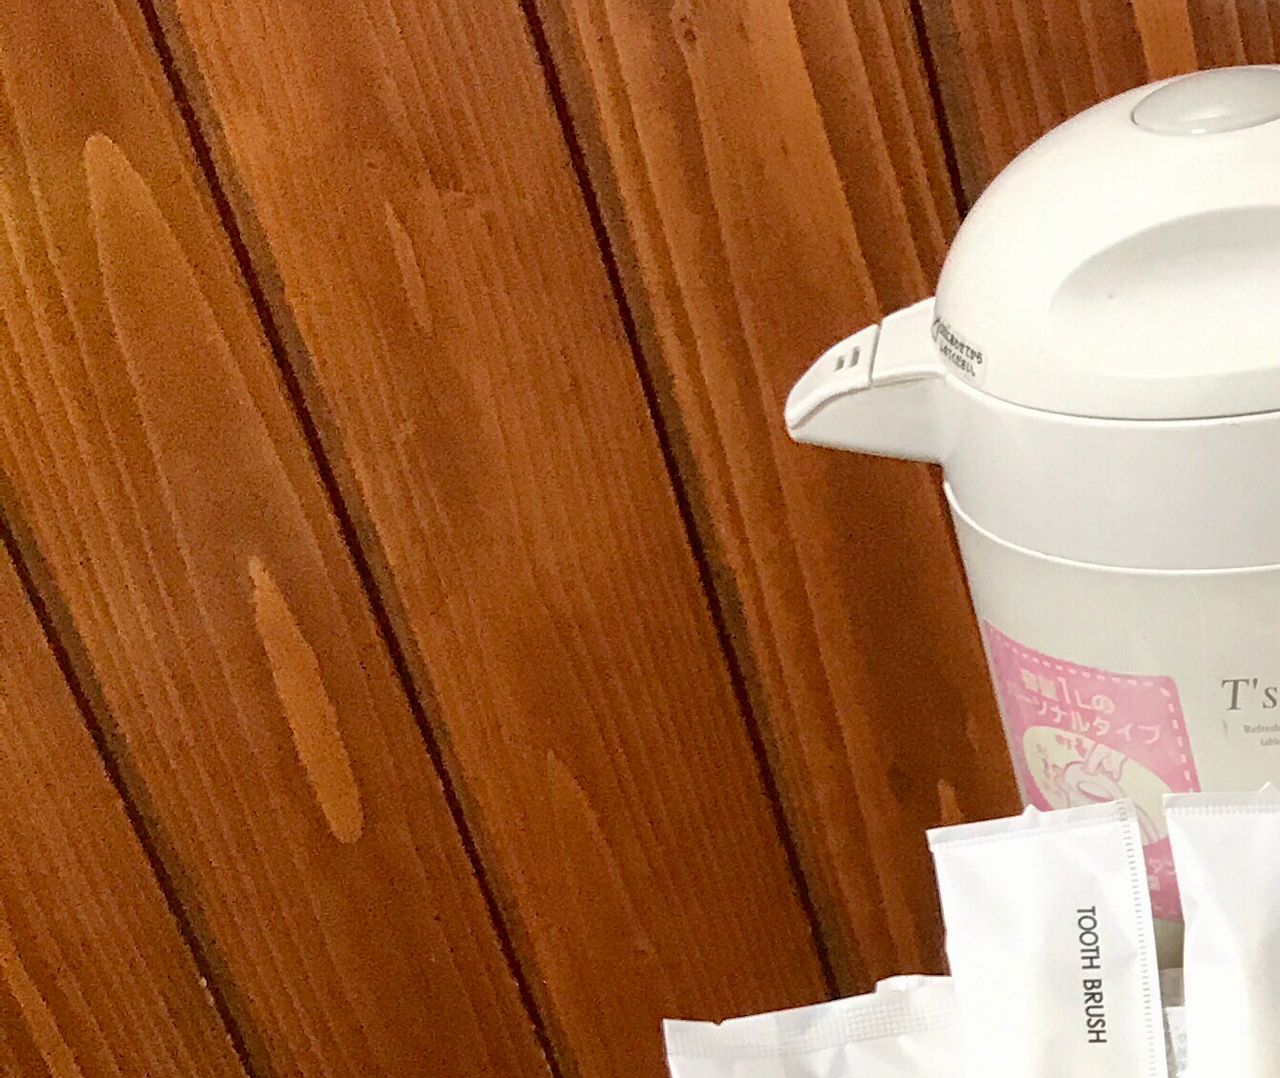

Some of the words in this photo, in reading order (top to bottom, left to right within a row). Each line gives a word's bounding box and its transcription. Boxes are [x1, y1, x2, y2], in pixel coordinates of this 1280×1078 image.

[1221, 678, 1279, 711] T's
[1076, 906, 1101, 969] TOOTH
[1083, 978, 1108, 1043] BRUSH
